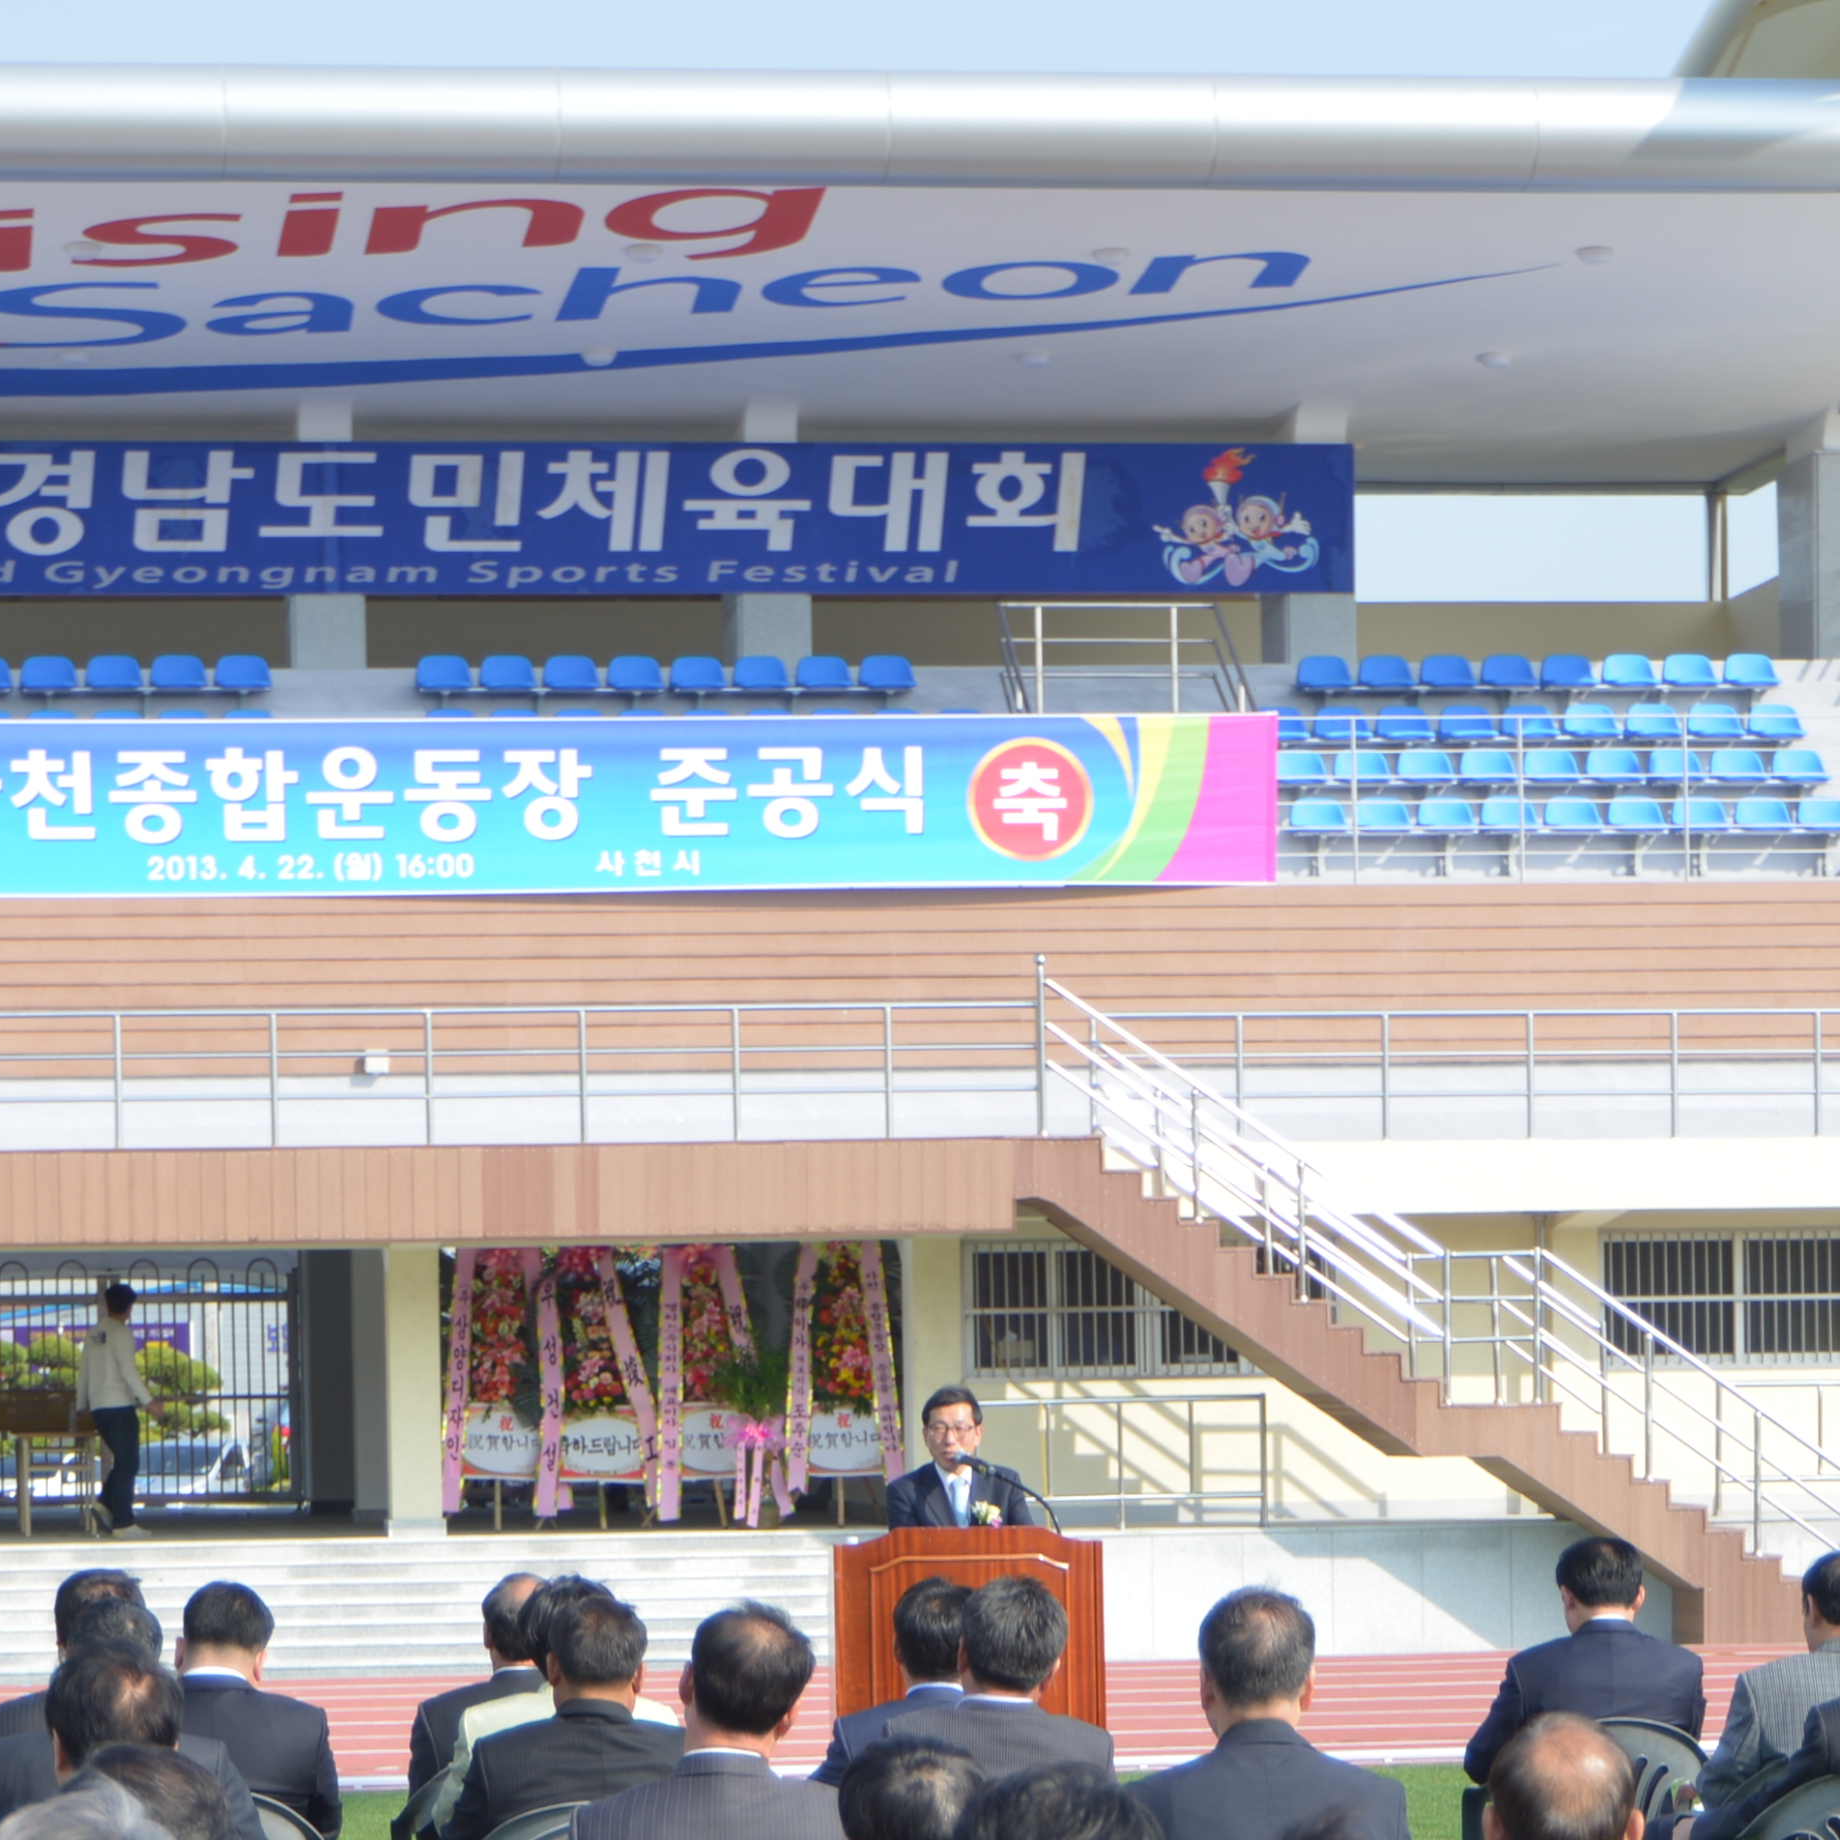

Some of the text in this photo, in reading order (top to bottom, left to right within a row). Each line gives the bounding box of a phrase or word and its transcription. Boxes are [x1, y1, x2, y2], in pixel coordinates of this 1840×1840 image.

[42, 559, 437, 589] Gyeongnam
[468, 558, 679, 588] Sports
[707, 557, 960, 584] Festival
[649, 745, 926, 843] 준공식
[992, 762, 1068, 843] 축
[147, 851, 475, 882] 2013. 4. 22. (월) 16:00
